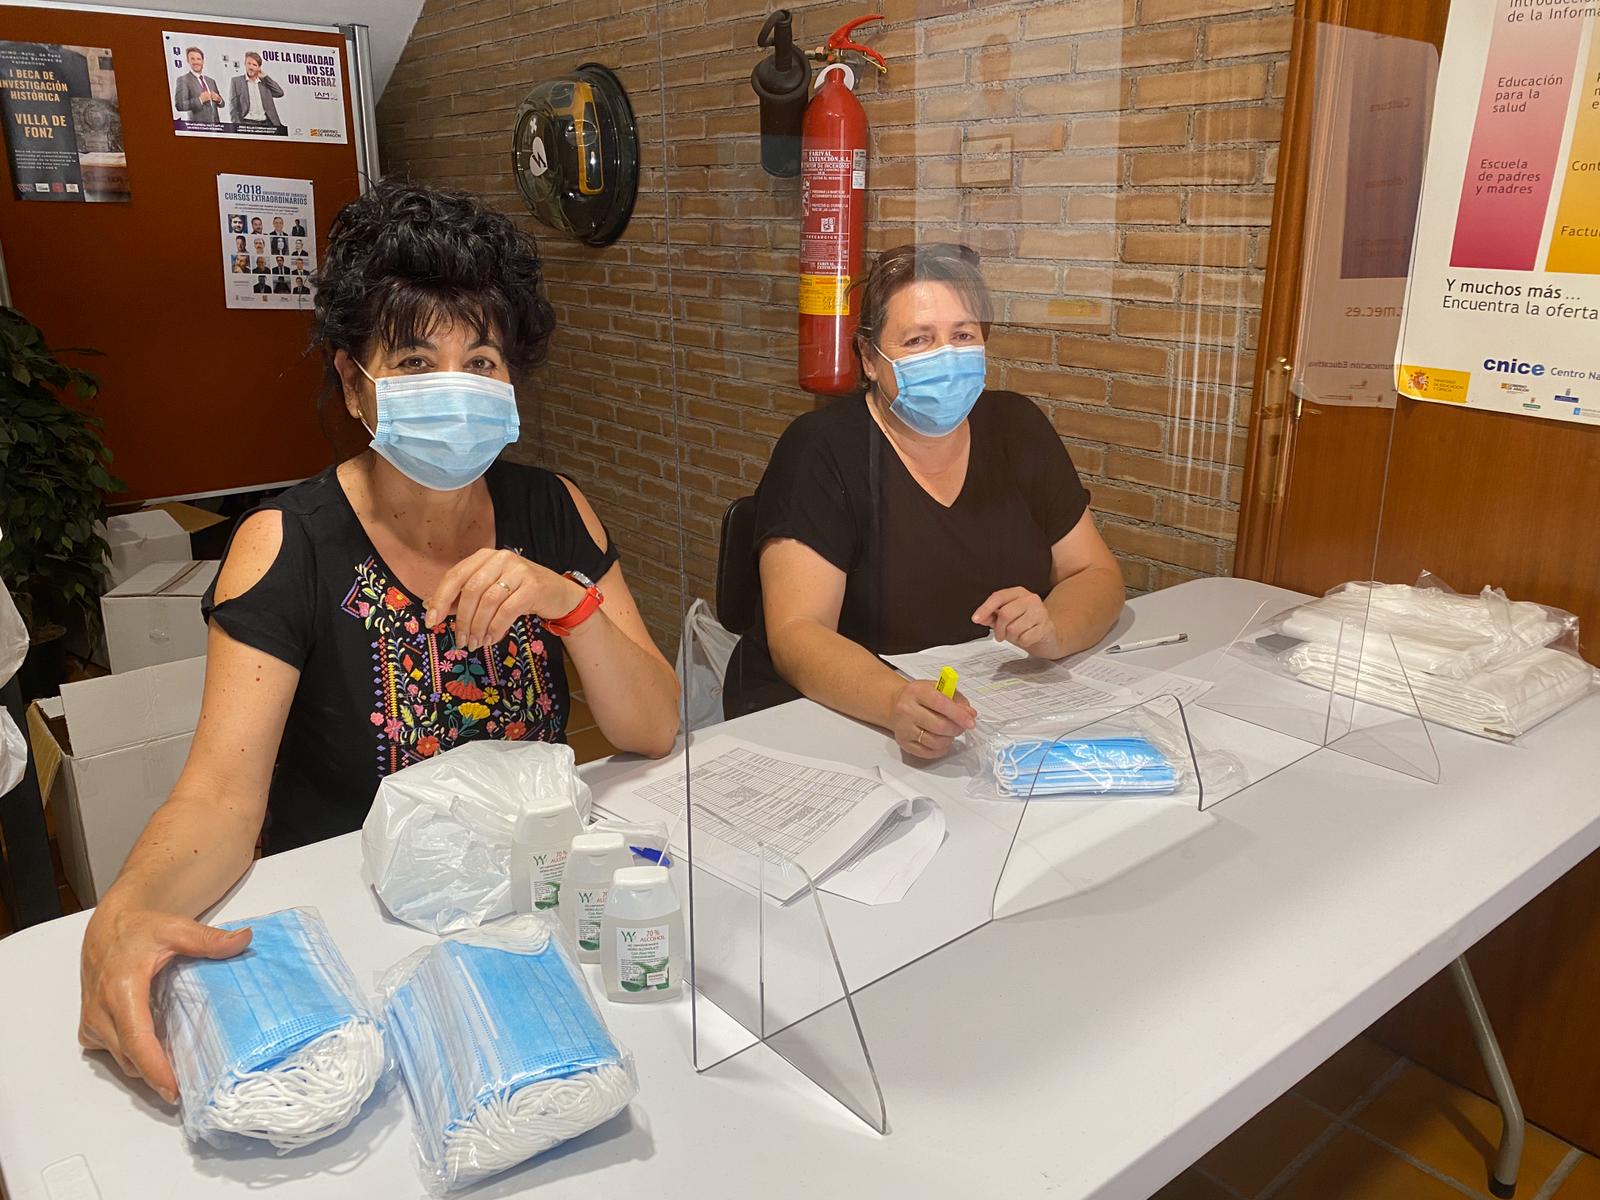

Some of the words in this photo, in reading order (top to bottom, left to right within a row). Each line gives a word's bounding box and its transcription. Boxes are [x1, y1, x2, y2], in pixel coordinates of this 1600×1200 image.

[1508, 10, 1524, 22] de
[1531, 9, 1542, 20] la
[263, 51, 279, 61] QUE
[281, 52, 291, 62] LA
[294, 53, 334, 66] IGUALDAD
[16, 69, 40, 79] BECA
[43, 71, 54, 80] DE
[306, 66, 318, 75] NO
[320, 67, 335, 76] SEA
[0, 80, 68, 92] INVESTIGACIÓN
[288, 74, 300, 84] UN
[302, 76, 336, 87] DISFRAZ
[1498, 74, 1563, 87] Educación
[10, 90, 60, 102] HISTÓRICA
[1495, 91, 1523, 102] para
[1529, 89, 1540, 99] la
[1493, 102, 1526, 113] salud
[15, 113, 48, 125] VILLA
[52, 115, 67, 126] DE
[25, 127, 54, 138] FONZ
[1480, 158, 1528, 169] Escuela
[1478, 172, 1493, 181] de
[1497, 172, 1541, 183] padres
[237, 184, 261, 194] 2018
[1476, 185, 1483, 196] y
[1487, 184, 1533, 194] madres
[225, 193, 250, 201] CURSOS
[252, 195, 307, 205] EXTRAORDINARIOS
[1560, 226, 1600, 237] Factu
[1446, 279, 1456, 292] Y
[1460, 282, 1522, 296] muchos
[1443, 296, 1519, 314] Encuentra
[1526, 301, 1539, 315] la
[1546, 303, 1598, 320] oferta
[1484, 358, 1545, 376] cnice
[1550, 368, 1585, 378] Centro
